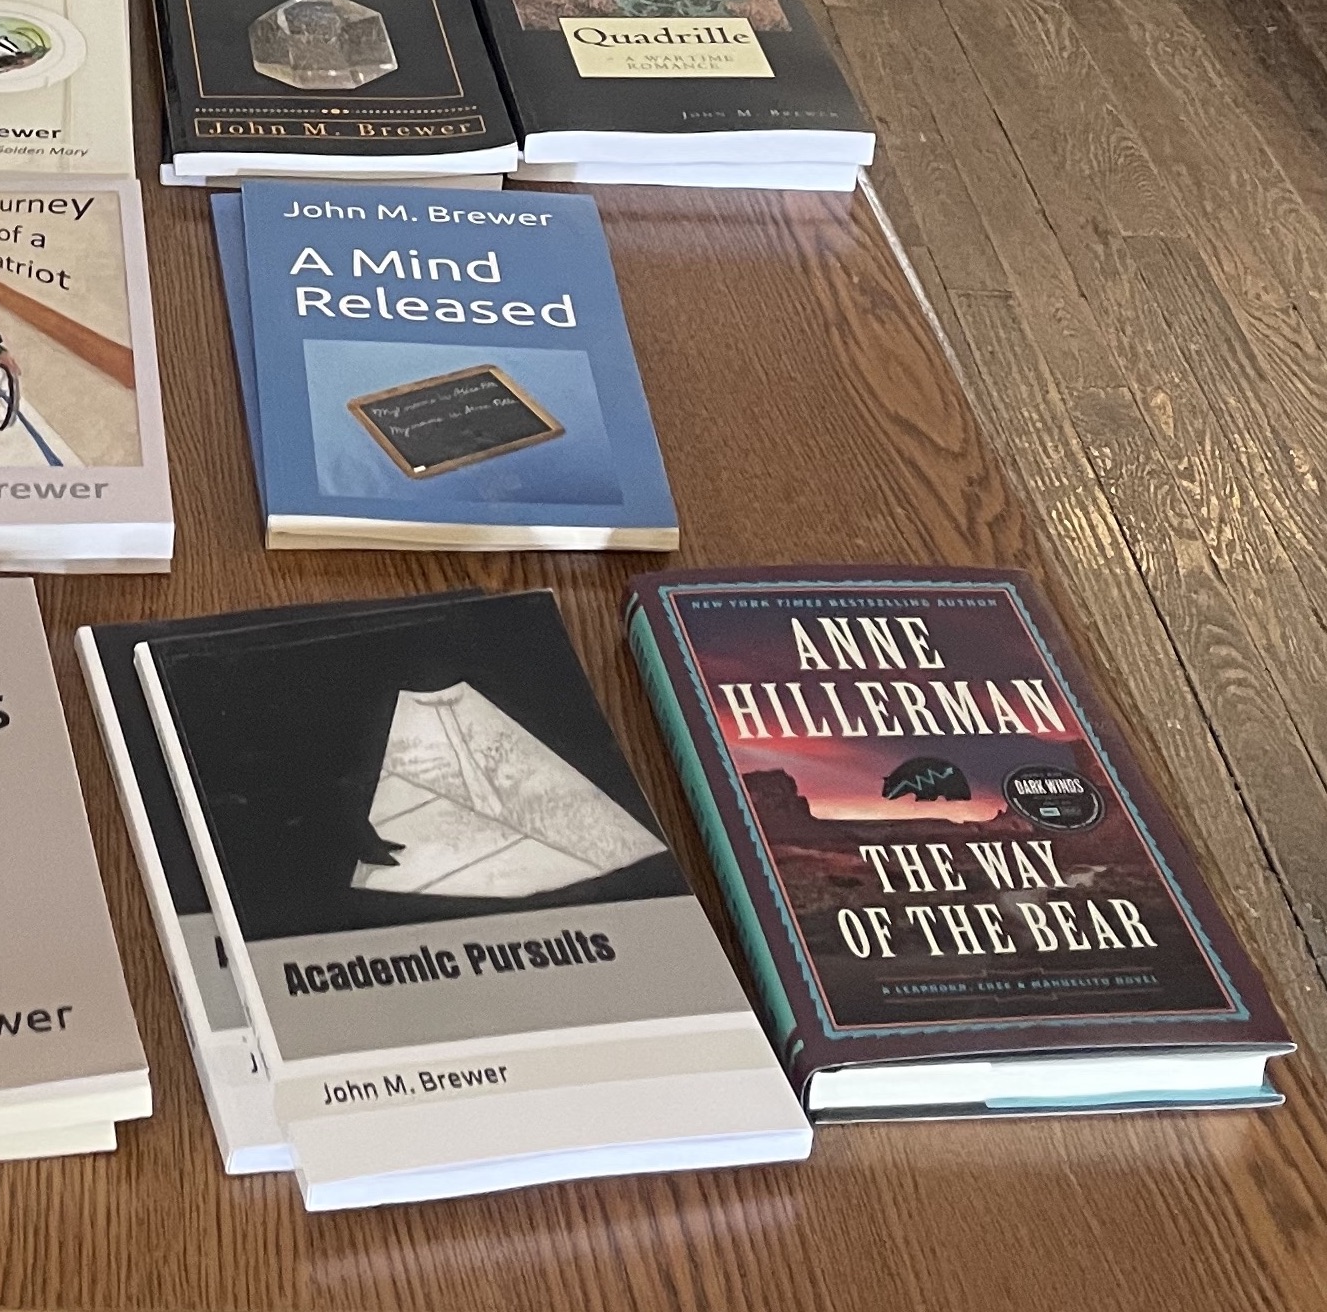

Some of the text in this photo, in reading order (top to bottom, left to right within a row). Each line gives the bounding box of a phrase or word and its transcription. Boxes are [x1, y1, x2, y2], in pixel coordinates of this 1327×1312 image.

[573, 25, 752, 48] Quadrille
[208, 120, 473, 137] John M. Brewer
[49, 146, 89, 158] Mary
[283, 200, 553, 228] John M. Brewer
[29, 231, 47, 250] a
[289, 246, 503, 284] A Mind
[294, 285, 578, 329] Released
[691, 600, 723, 610] NEW
[936, 597, 999, 608] AUTHOR
[790, 616, 946, 671] ANNE
[717, 678, 1067, 740] HILLERMAN
[1014, 778, 1084, 795] DARK WINDS
[858, 839, 1072, 894] THE WAY
[836, 898, 1159, 959] OF THE BEAR
[283, 945, 461, 997] Academic
[463, 928, 617, 976] Pursuits
[323, 1064, 509, 1105] John M. Brewer
